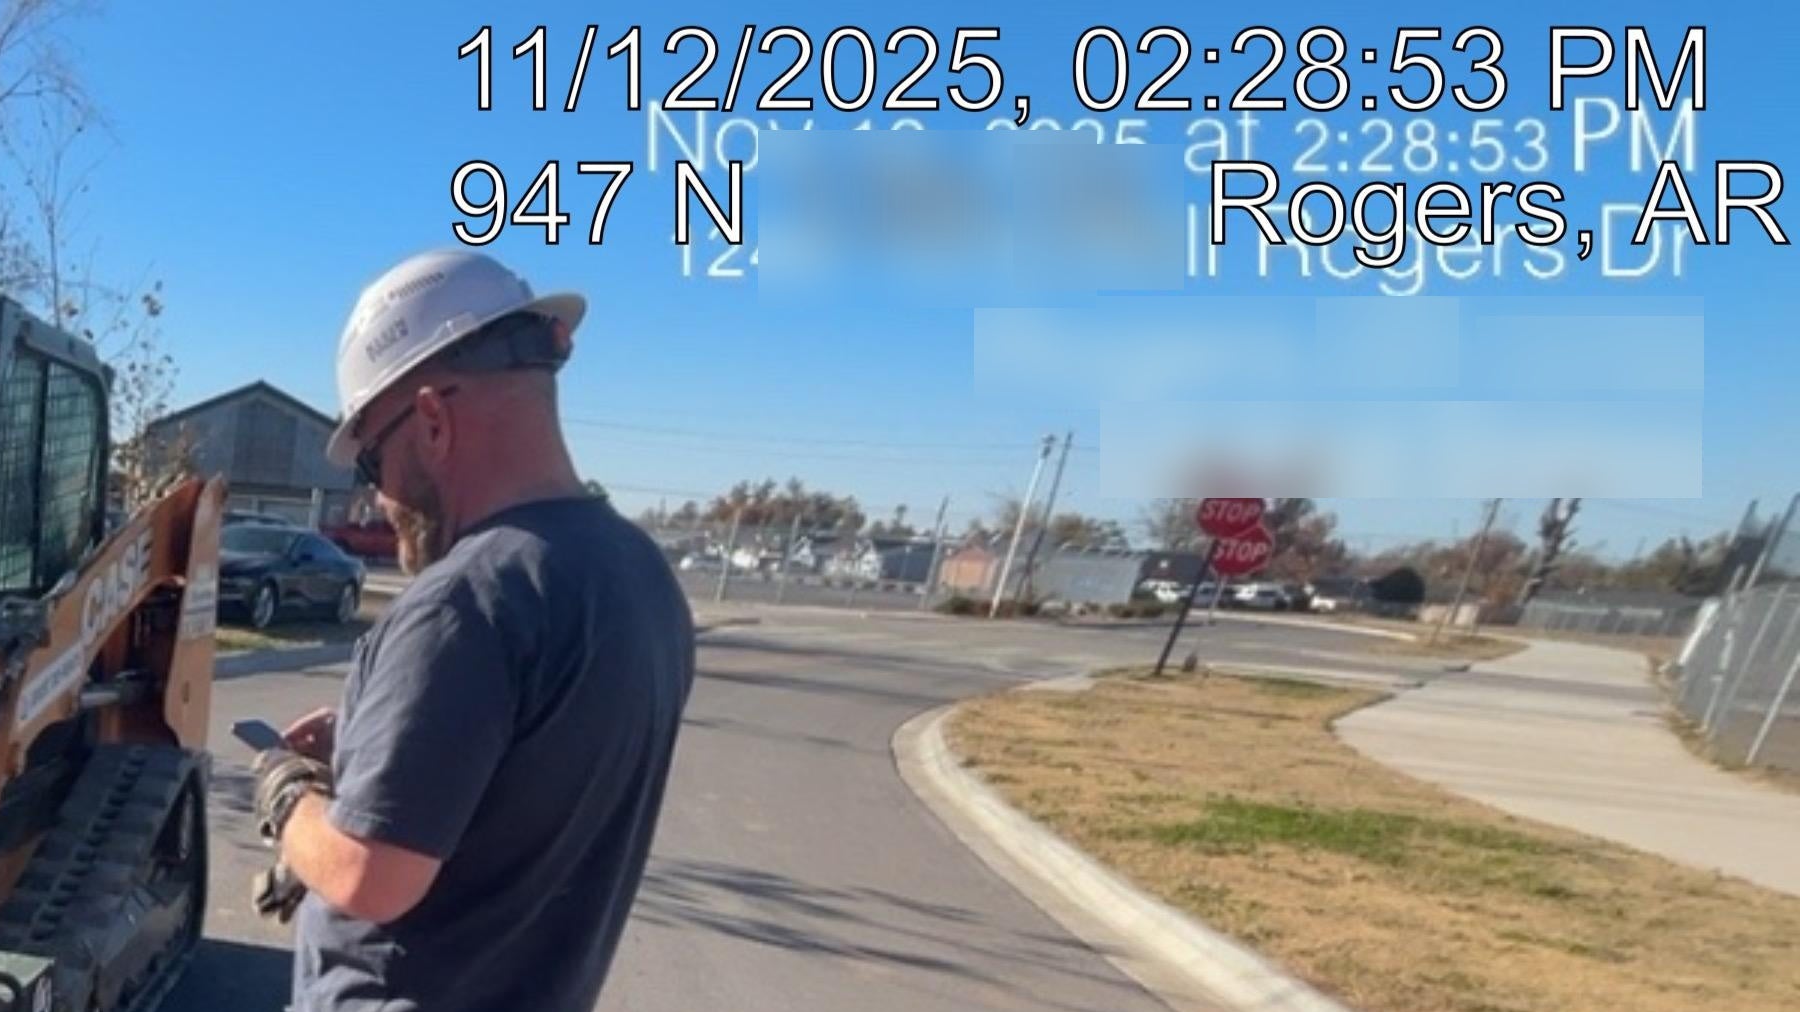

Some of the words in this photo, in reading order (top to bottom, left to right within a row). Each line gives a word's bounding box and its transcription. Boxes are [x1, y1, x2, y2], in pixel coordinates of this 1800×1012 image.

[1202, 502, 1262, 524] STOP
[1213, 540, 1268, 562] STOP
[81, 528, 154, 645] CASE
